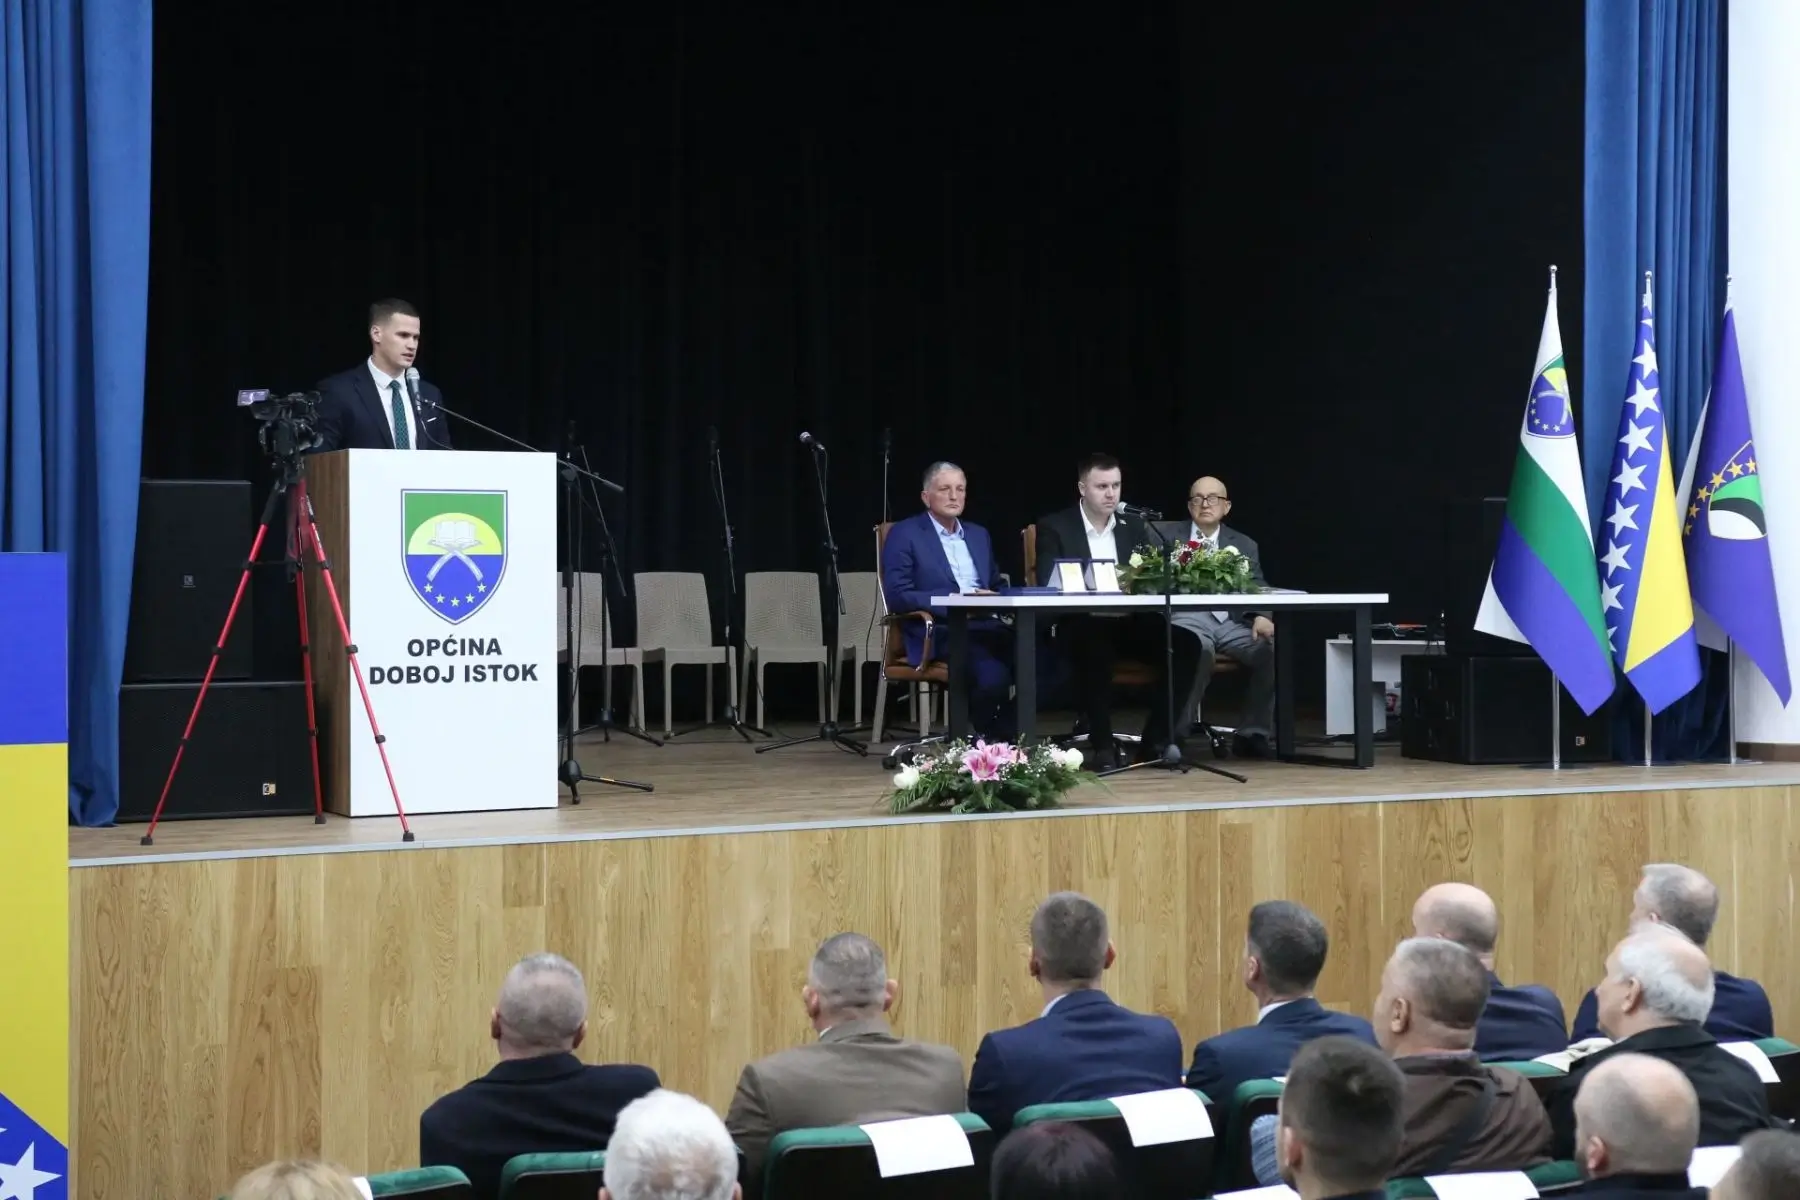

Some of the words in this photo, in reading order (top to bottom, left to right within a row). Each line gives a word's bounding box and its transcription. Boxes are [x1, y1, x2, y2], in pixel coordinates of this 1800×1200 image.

[407, 634, 502, 657] OPĆINA
[369, 665, 455, 685] DOBOJ
[464, 663, 538, 683] ISTOK
